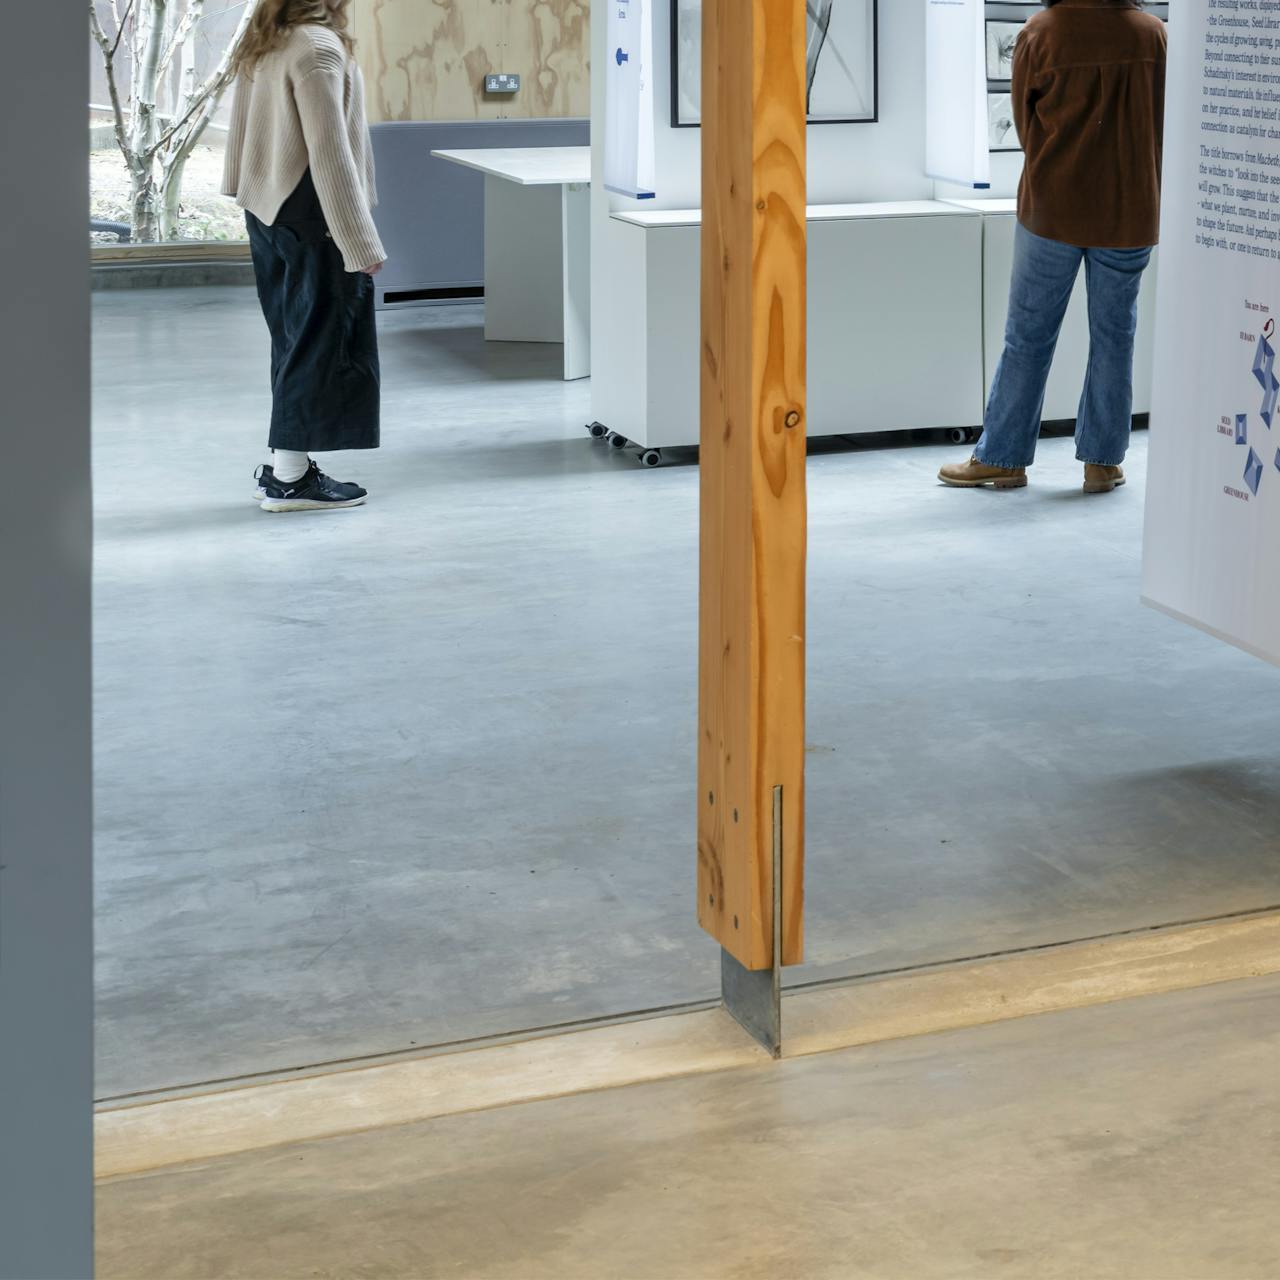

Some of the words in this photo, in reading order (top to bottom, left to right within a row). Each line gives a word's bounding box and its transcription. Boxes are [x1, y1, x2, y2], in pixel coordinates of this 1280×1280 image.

[1242, 106, 1252, 118] and
[1200, 145, 1210, 157] The
[1260, 171, 1268, 183] the
[1223, 184, 1234, 196] This
[1257, 189, 1268, 202] that
[1269, 191, 1279, 203] the
[1258, 209, 1269, 220] and
[1217, 219, 1225, 230] the
[1255, 226, 1277, 242] perhaps
[1223, 486, 1249, 502] GREENHOUSE
